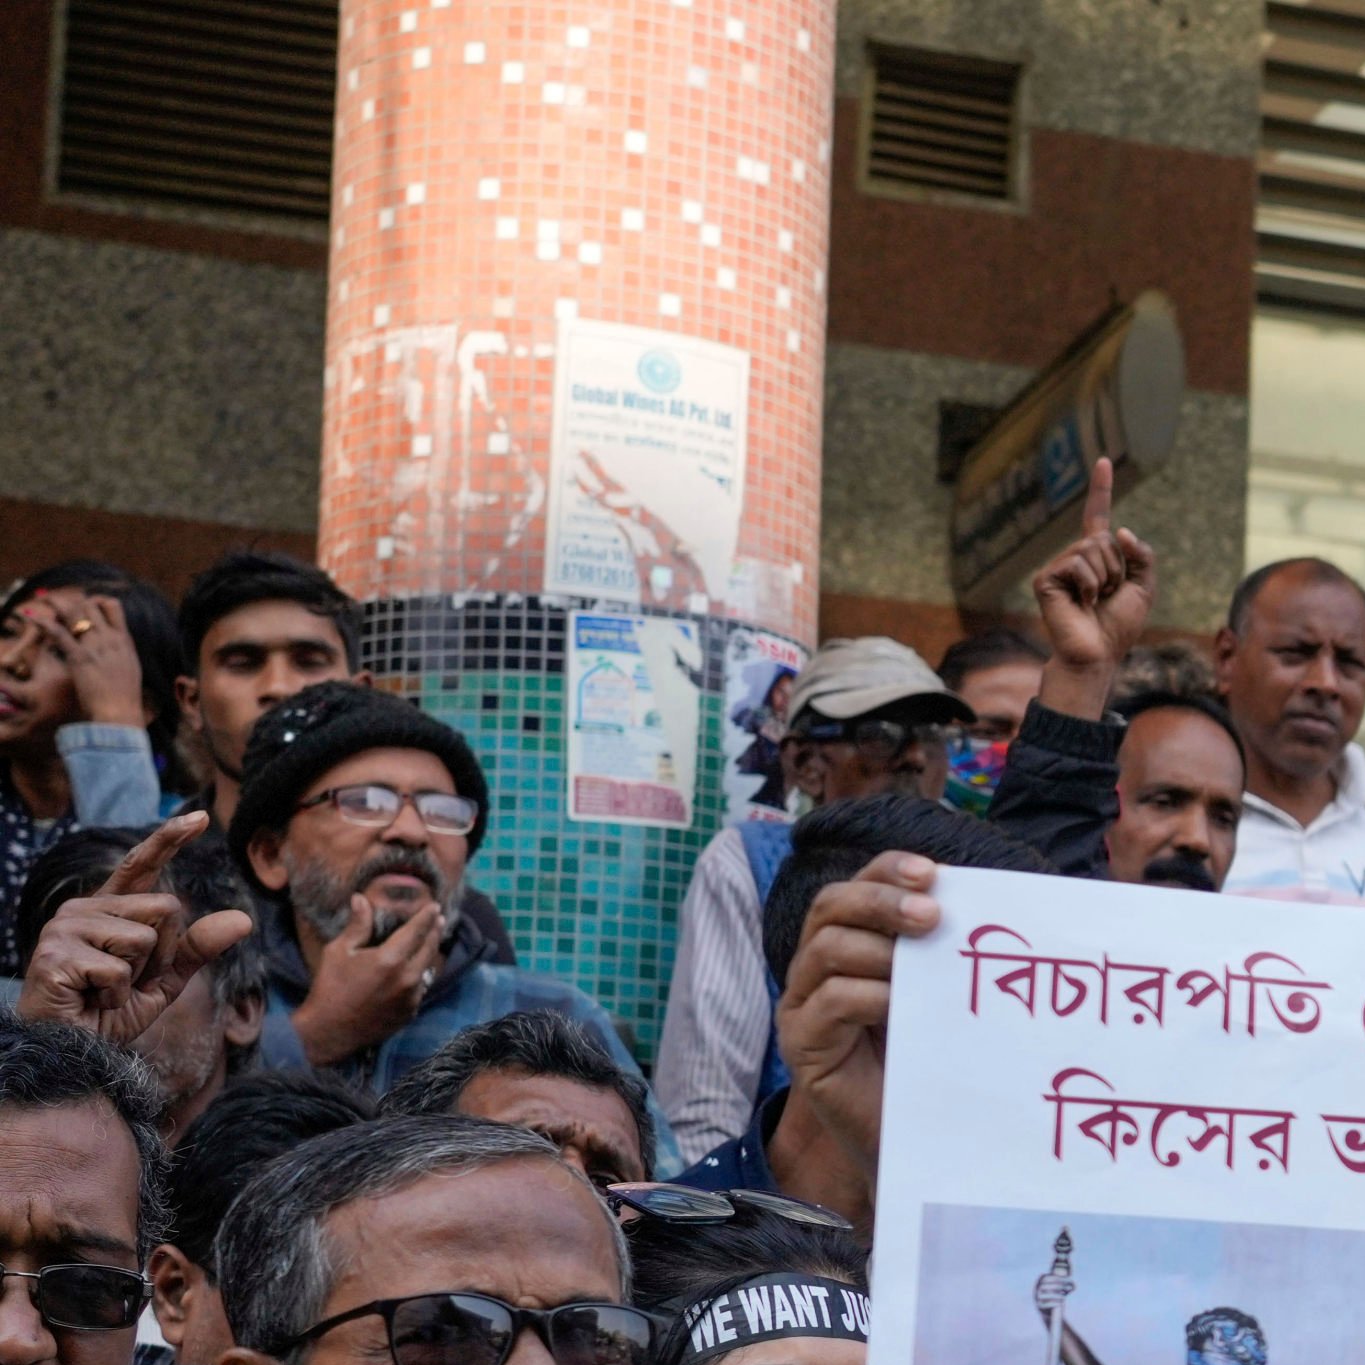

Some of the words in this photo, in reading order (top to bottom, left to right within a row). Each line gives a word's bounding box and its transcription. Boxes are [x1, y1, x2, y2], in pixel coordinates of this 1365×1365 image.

[572, 383, 618, 406] Global
[957, 922, 1331, 1040] বিচারপতি
[1042, 1065, 1298, 1174] কিসের
[684, 1293, 738, 1353] WE
[737, 1283, 833, 1335] WANT
